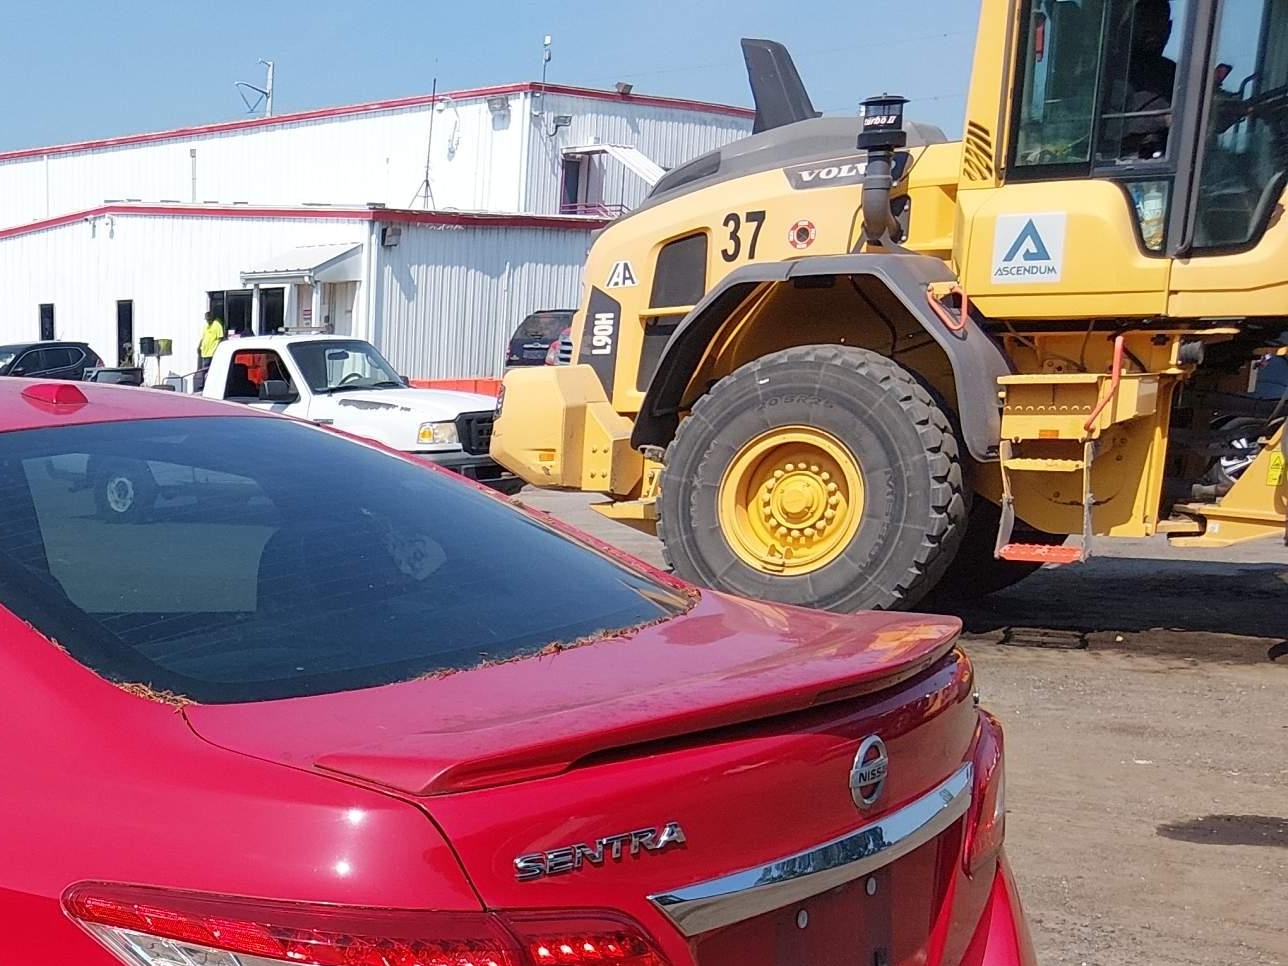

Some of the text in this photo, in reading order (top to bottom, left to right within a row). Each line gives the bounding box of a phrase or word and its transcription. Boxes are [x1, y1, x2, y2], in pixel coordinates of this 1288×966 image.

[799, 163, 896, 182] VOLV
[721, 210, 766, 262] 37
[994, 265, 1057, 276] ASCENDUM
[591, 312, 615, 355] L90H
[513, 821, 686, 881] SENTRA
